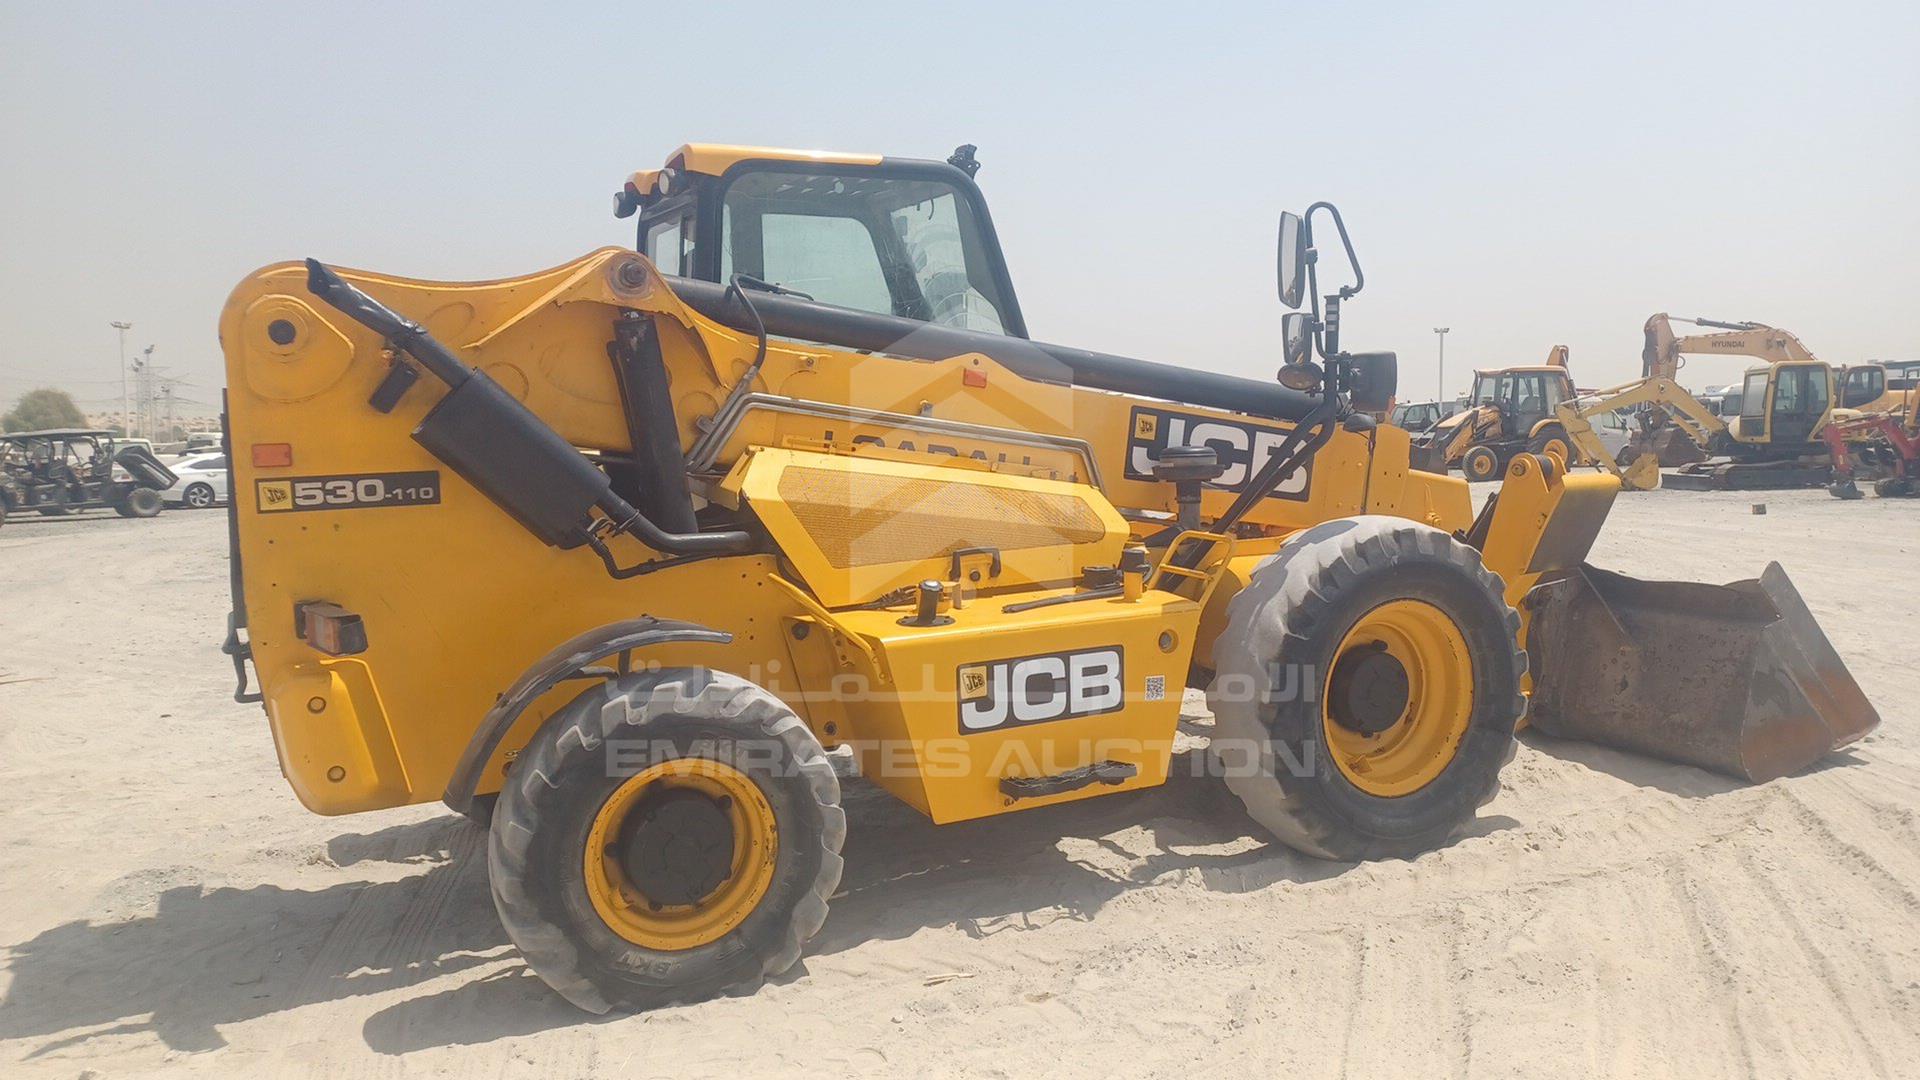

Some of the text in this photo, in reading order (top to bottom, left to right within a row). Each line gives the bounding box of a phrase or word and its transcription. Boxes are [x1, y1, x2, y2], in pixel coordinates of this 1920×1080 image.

[1711, 340, 1745, 348] HYUNDAI
[1132, 418, 1307, 494] JCB
[266, 479, 435, 505] JCB 530-110
[962, 650, 1122, 729] JCB
[964, 673, 986, 692] JCB
